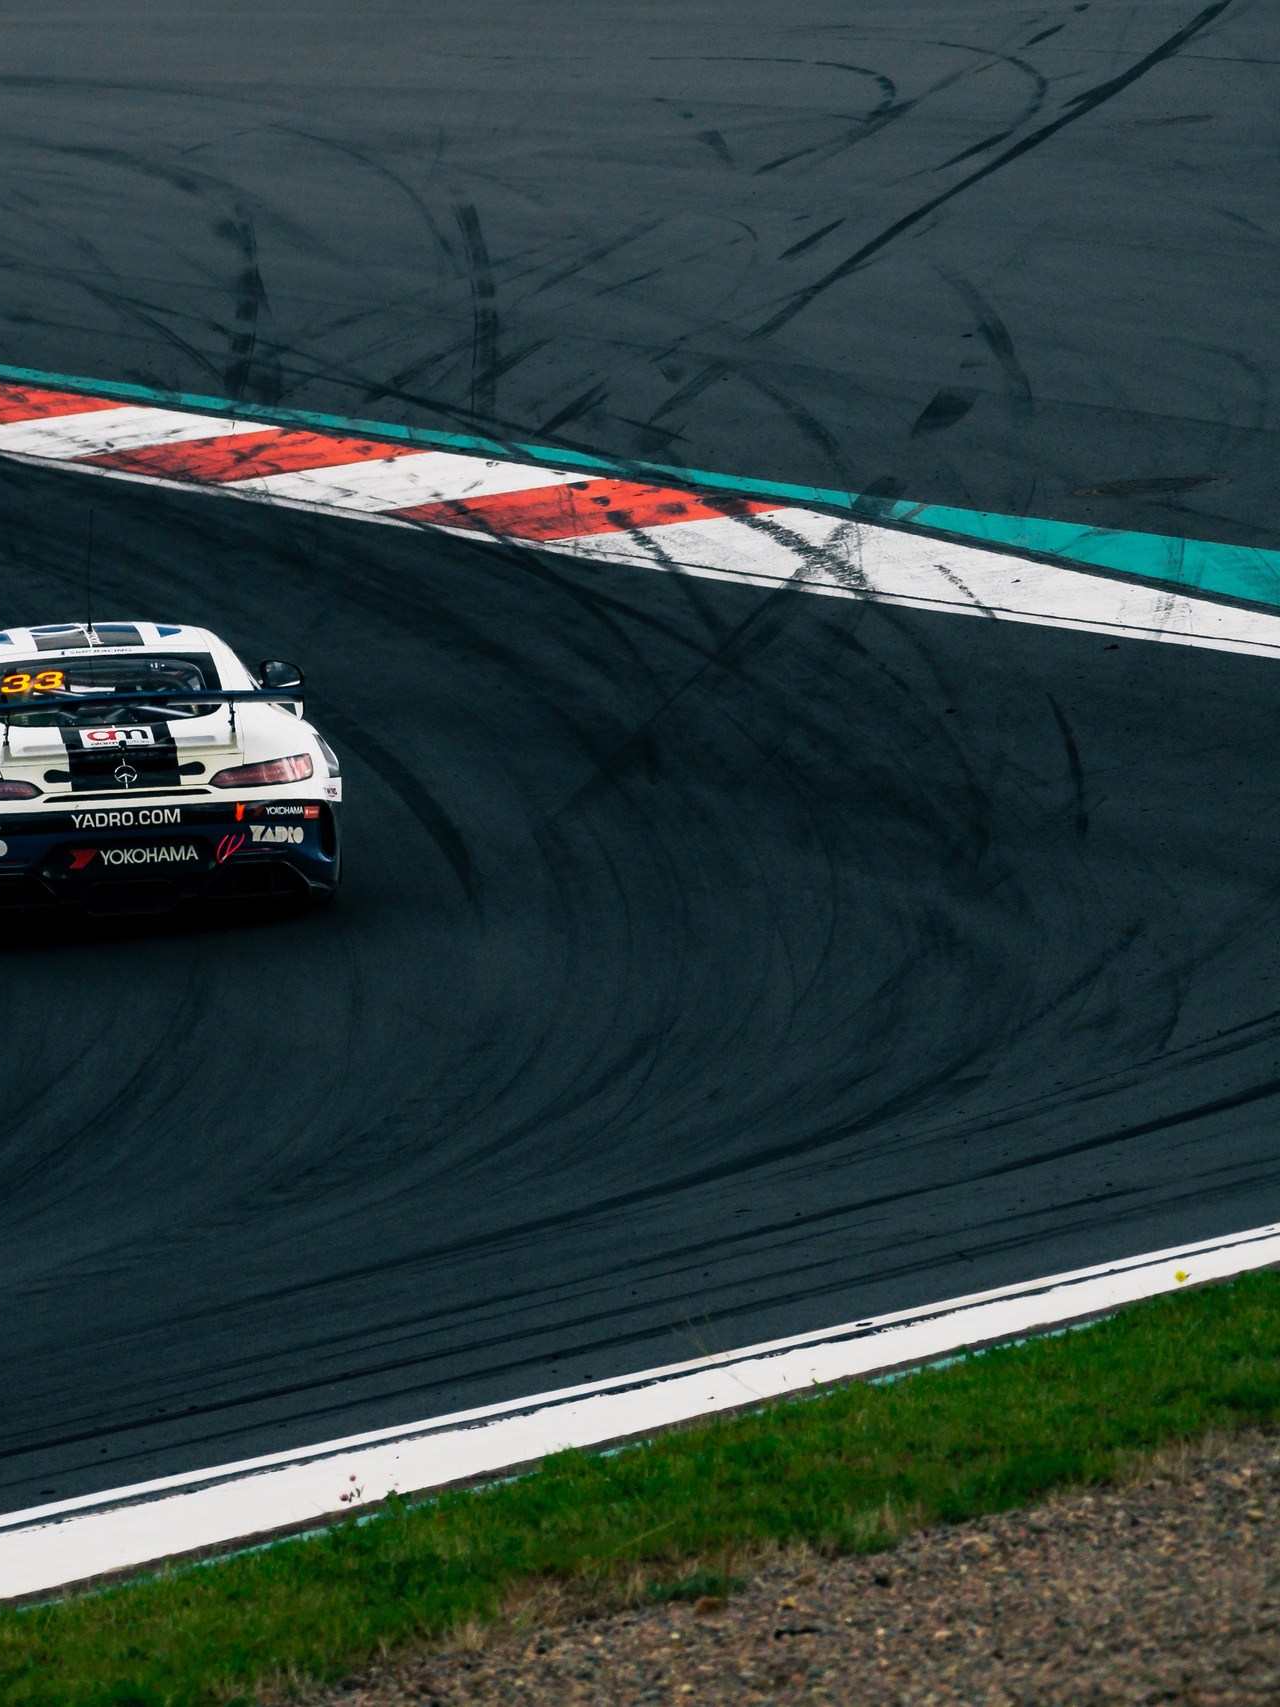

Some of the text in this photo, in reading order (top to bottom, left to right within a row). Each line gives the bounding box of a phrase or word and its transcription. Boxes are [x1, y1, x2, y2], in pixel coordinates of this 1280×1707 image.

[1, 670, 64, 694] 33
[87, 729, 149, 741] am
[71, 808, 181, 829] YADRO.COM
[265, 806, 304, 815] YOKOHAMA
[249, 825, 304, 844] YADRO
[99, 845, 199, 865] YOKOHAMA
